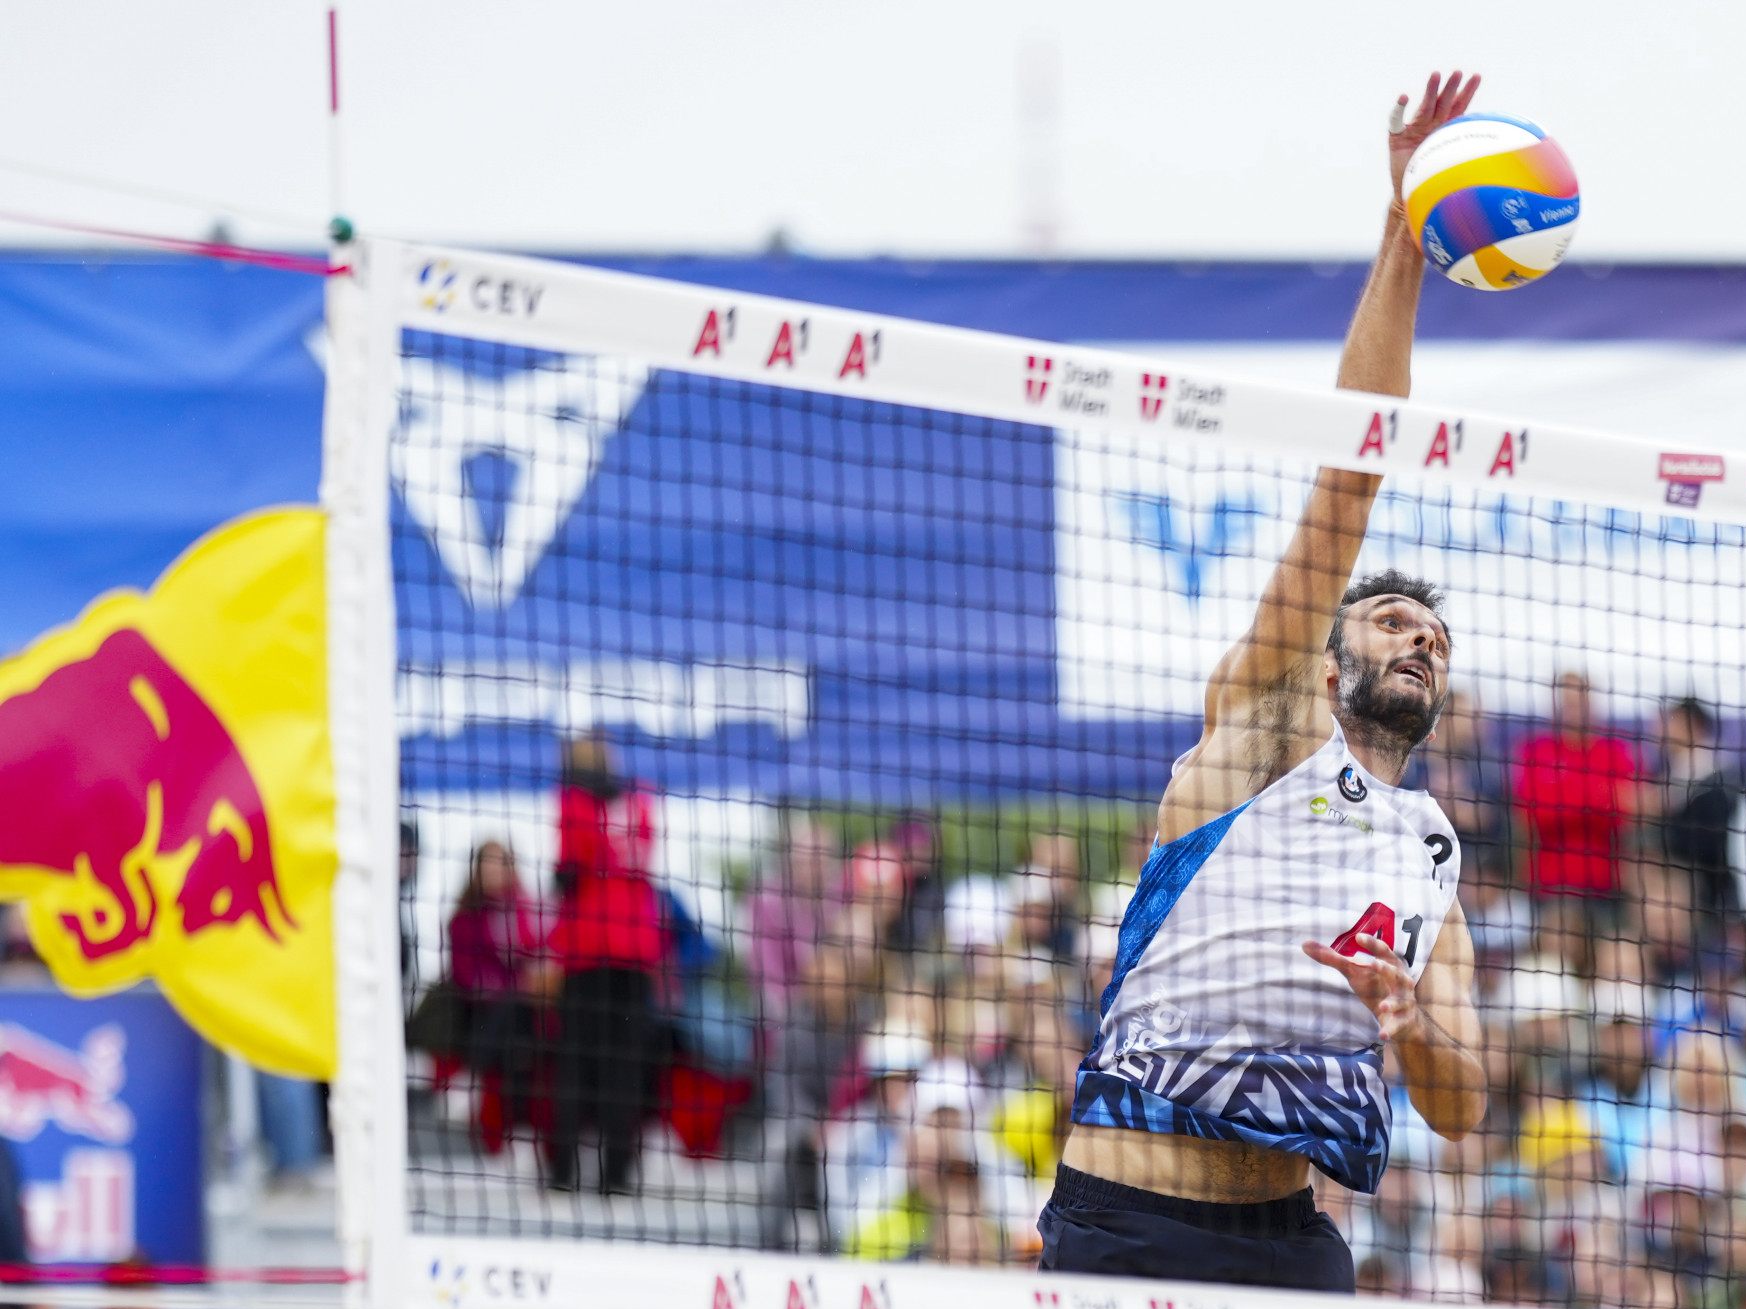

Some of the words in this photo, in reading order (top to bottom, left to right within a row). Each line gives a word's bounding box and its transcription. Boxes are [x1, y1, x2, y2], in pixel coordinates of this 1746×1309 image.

[469, 275, 543, 317] CEV
[693, 306, 736, 357] A1
[766, 318, 808, 367] A1
[839, 330, 881, 379] A1
[1358, 409, 1397, 456] A1
[1425, 419, 1463, 466] A1
[1489, 429, 1528, 477] A1
[1330, 902, 1423, 968] A1
